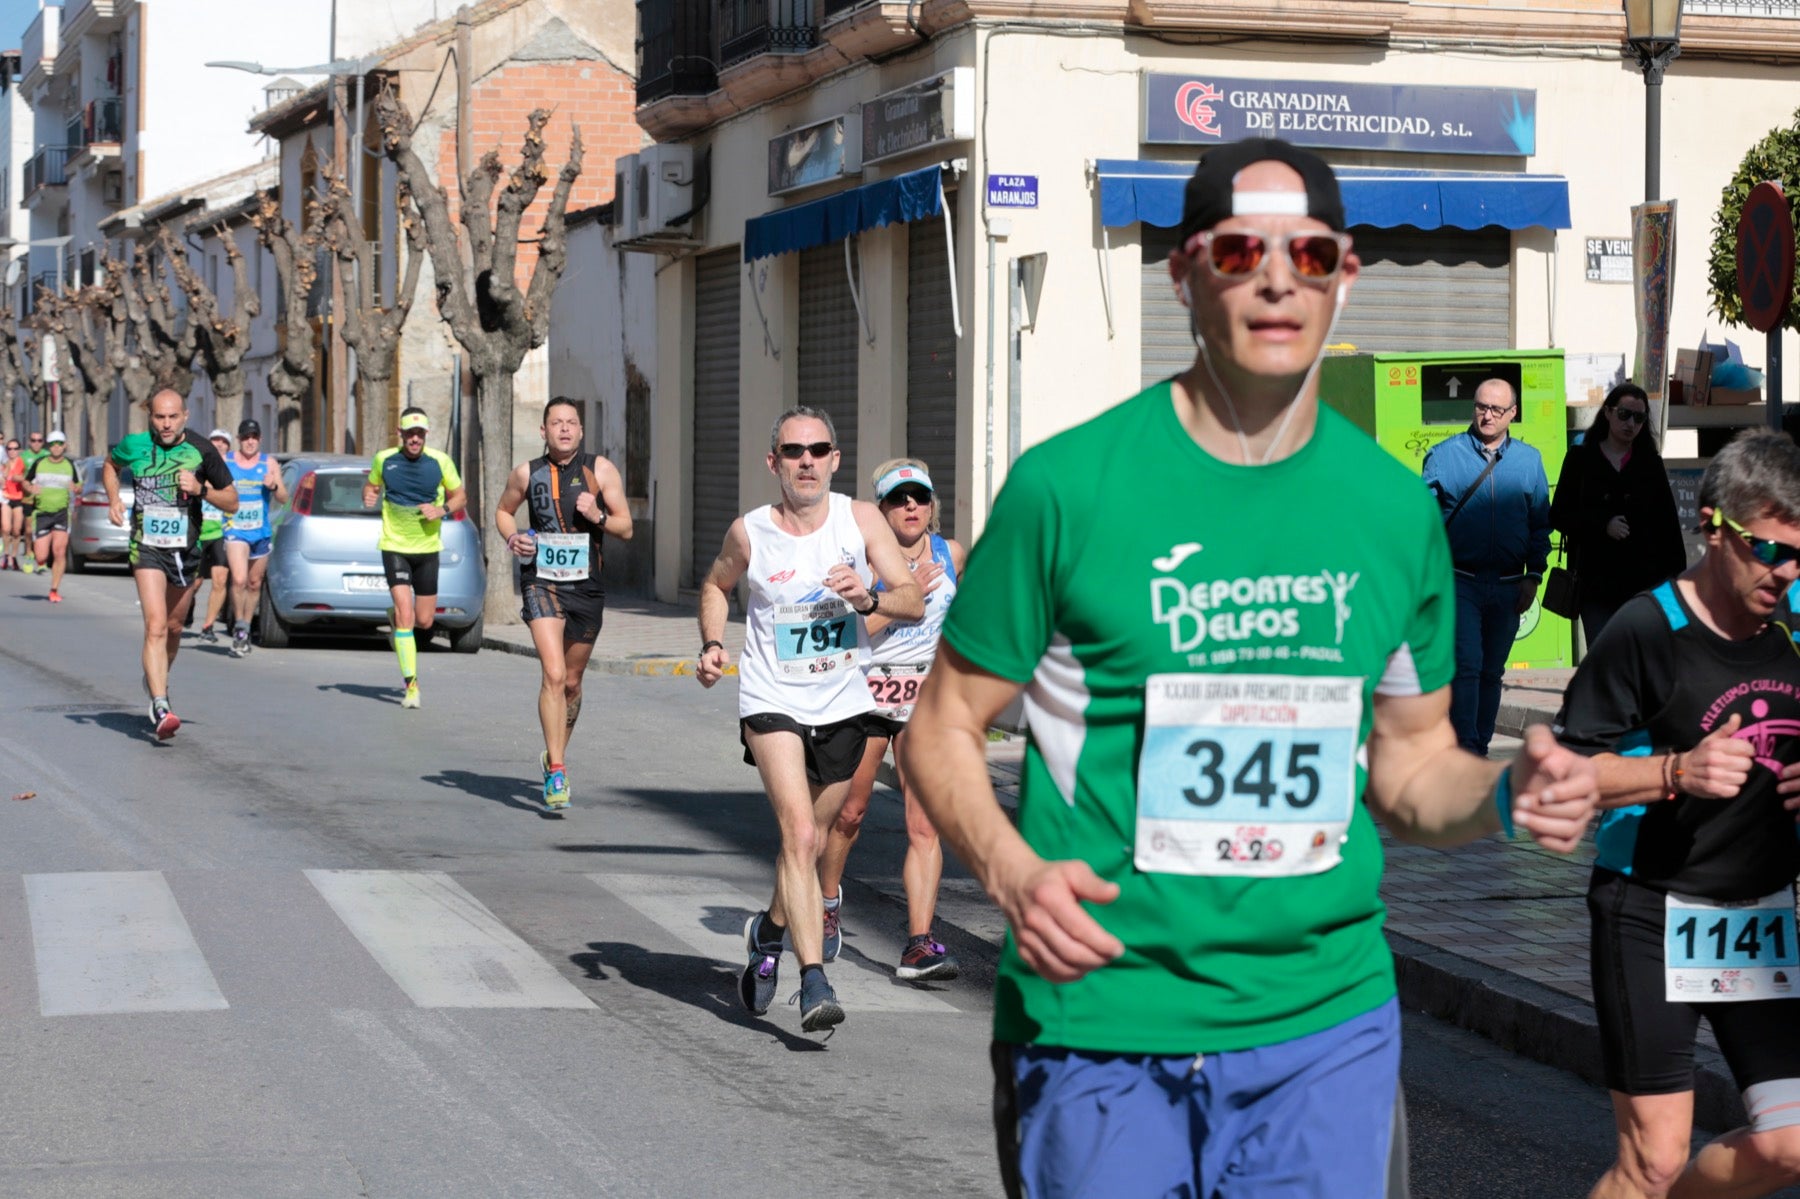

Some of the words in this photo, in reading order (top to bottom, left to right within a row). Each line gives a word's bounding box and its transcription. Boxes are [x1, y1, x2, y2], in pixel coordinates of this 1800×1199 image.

[1229, 91, 1352, 112] GRANADINA
[1246, 111, 1274, 129] DE
[1279, 112, 1435, 137] ELECTRICIDAD,
[1441, 123, 1473, 137] S.L.
[998, 177, 1026, 187] PLAZA
[990, 190, 1036, 205] NARANJOS
[1587, 240, 1602, 255] SE
[238, 511, 258, 519] 449
[151, 519, 180, 534] 529
[545, 548, 580, 565] 967
[1150, 575, 1328, 624] DEPORTES
[790, 620, 846, 655] 797
[1168, 605, 1300, 653] DELFOS
[868, 680, 918, 703] 228
[1204, 682, 1240, 700] GRAN
[1243, 682, 1291, 701] PREMIO
[1294, 684, 1309, 702] DE
[1700, 682, 1750, 731] ATLETISMO
[1750, 679, 1793, 695] CULLAR
[1181, 738, 1321, 808] 345
[1676, 916, 1786, 960] 1141
